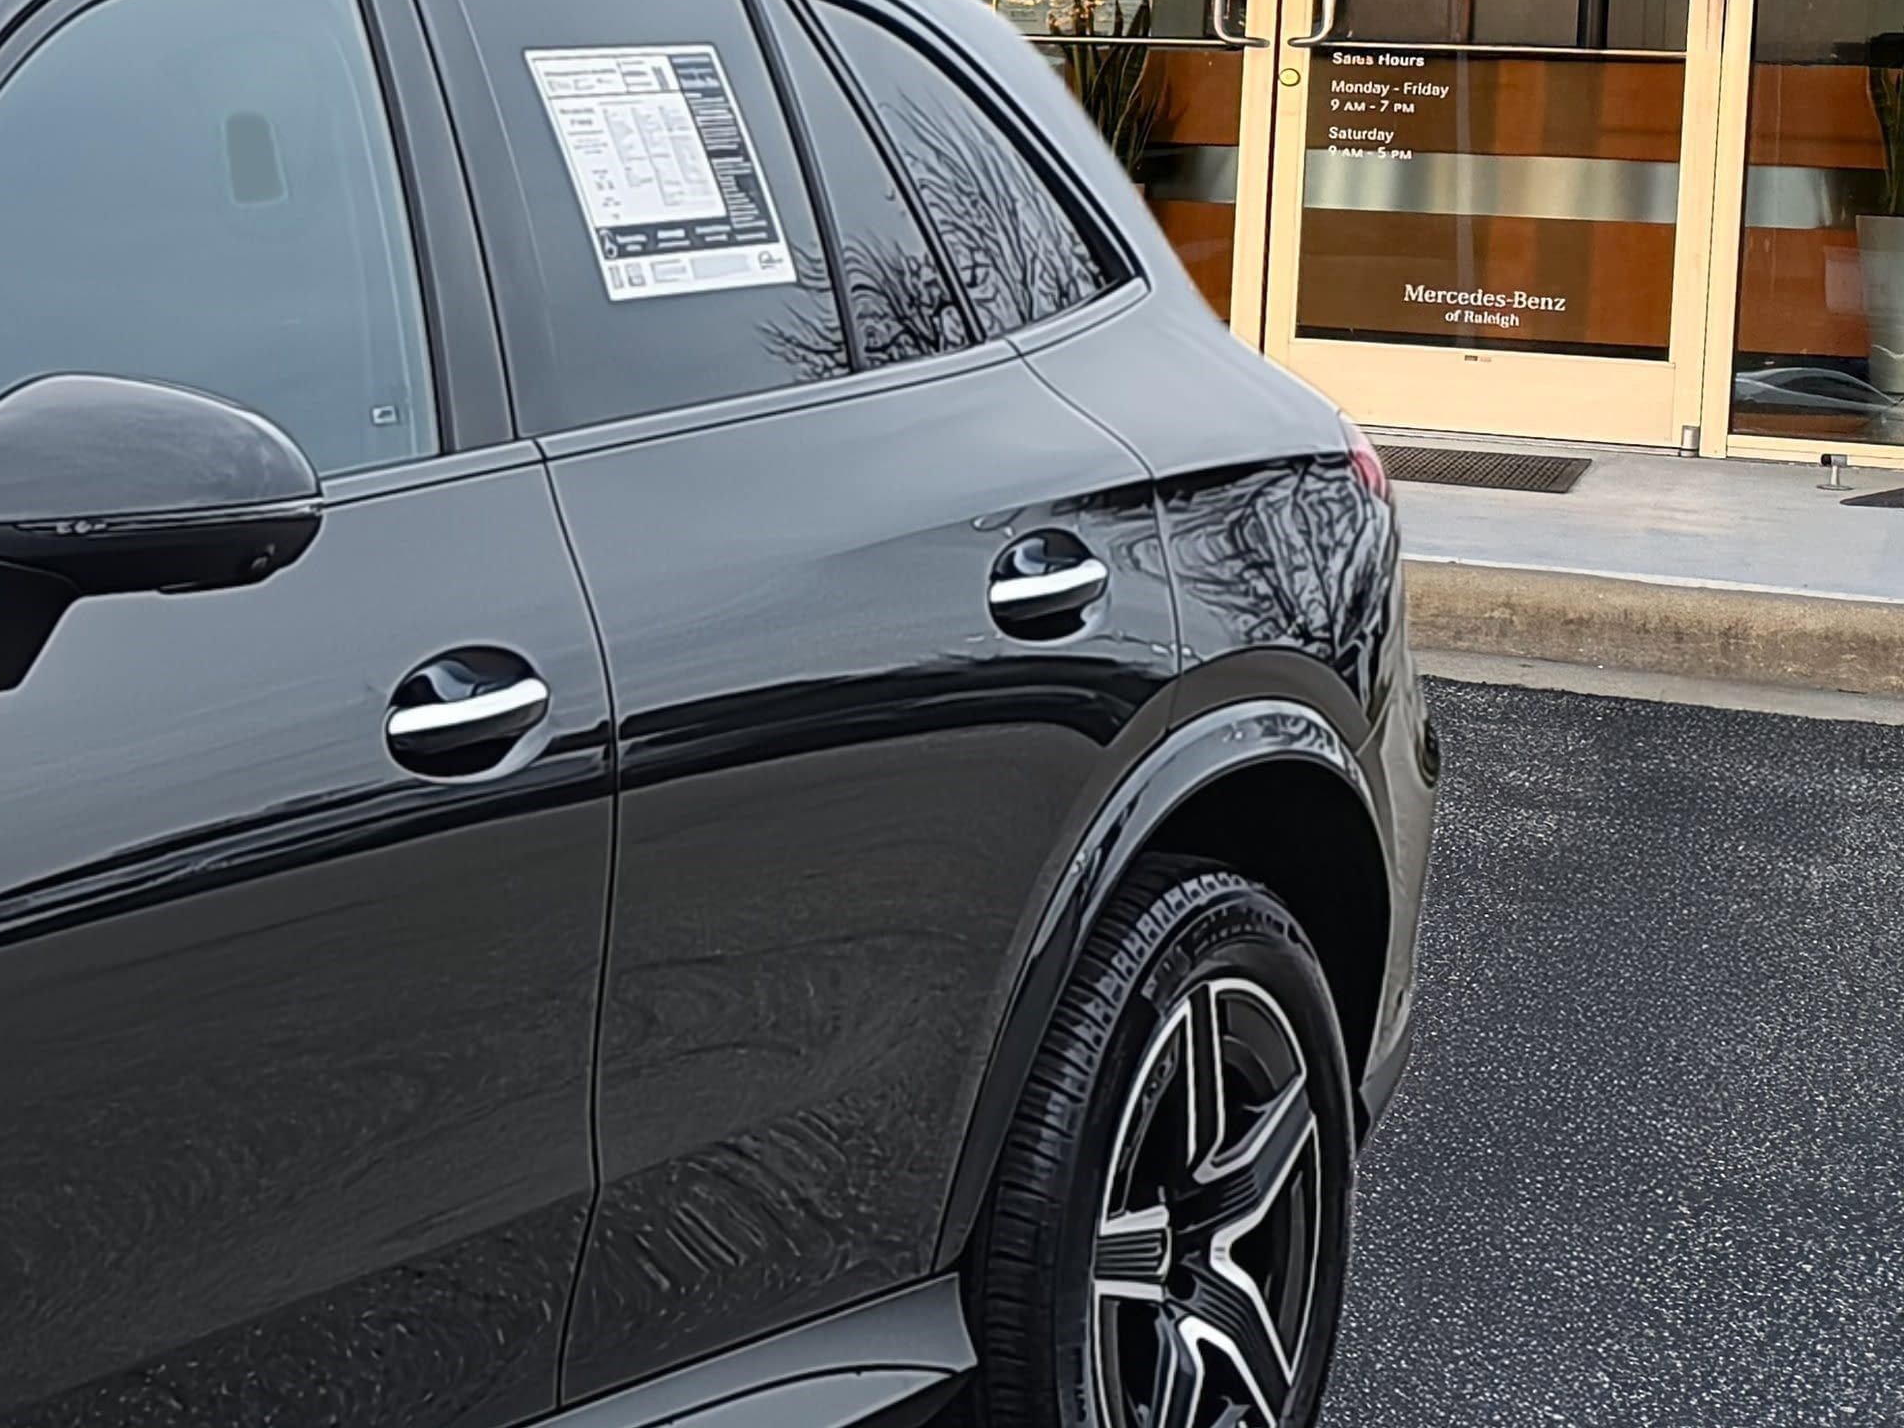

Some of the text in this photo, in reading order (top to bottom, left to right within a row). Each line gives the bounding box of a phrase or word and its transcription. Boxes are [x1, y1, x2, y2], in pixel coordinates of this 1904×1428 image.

[1378, 53, 1425, 67] Hours
[1331, 80, 1390, 97] Monday
[1403, 82, 1449, 98] Friday
[1330, 99, 1340, 111] 9
[1344, 102, 1366, 112] AM
[1380, 100, 1389, 113] 7
[1394, 103, 1415, 113] PM
[1328, 126, 1394, 143] Saturday
[1341, 148, 1363, 158] AM
[1377, 146, 1386, 158] 5
[1391, 149, 1412, 159] PM
[1404, 284, 1566, 312] Mercedes-Benz
[1445, 310, 1519, 329] of Raleigh
